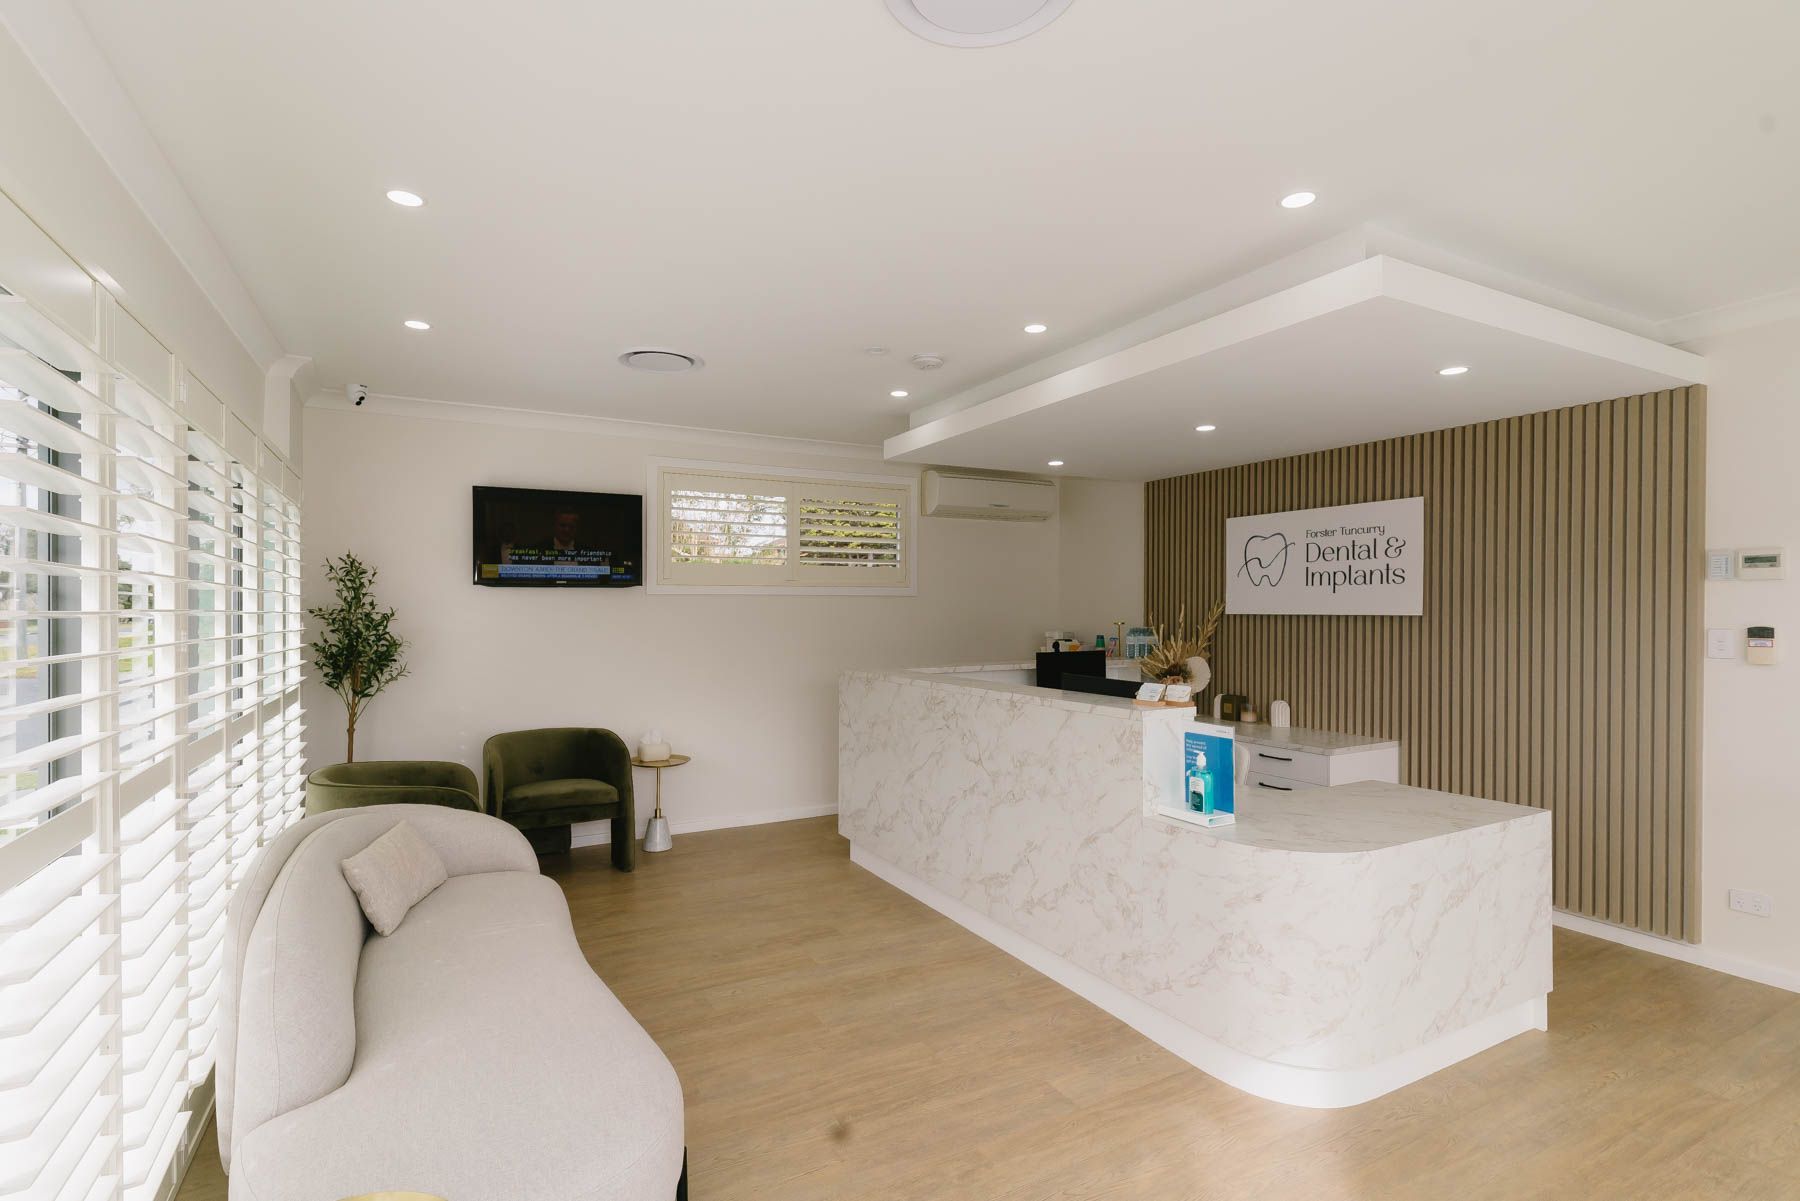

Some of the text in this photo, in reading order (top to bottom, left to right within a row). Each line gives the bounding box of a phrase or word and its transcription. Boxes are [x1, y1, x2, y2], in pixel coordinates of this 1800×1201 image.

[1305, 525, 1386, 539] Forster Tuncurry
[1305, 536, 1407, 563] Dental &
[1305, 563, 1407, 594] Implants
